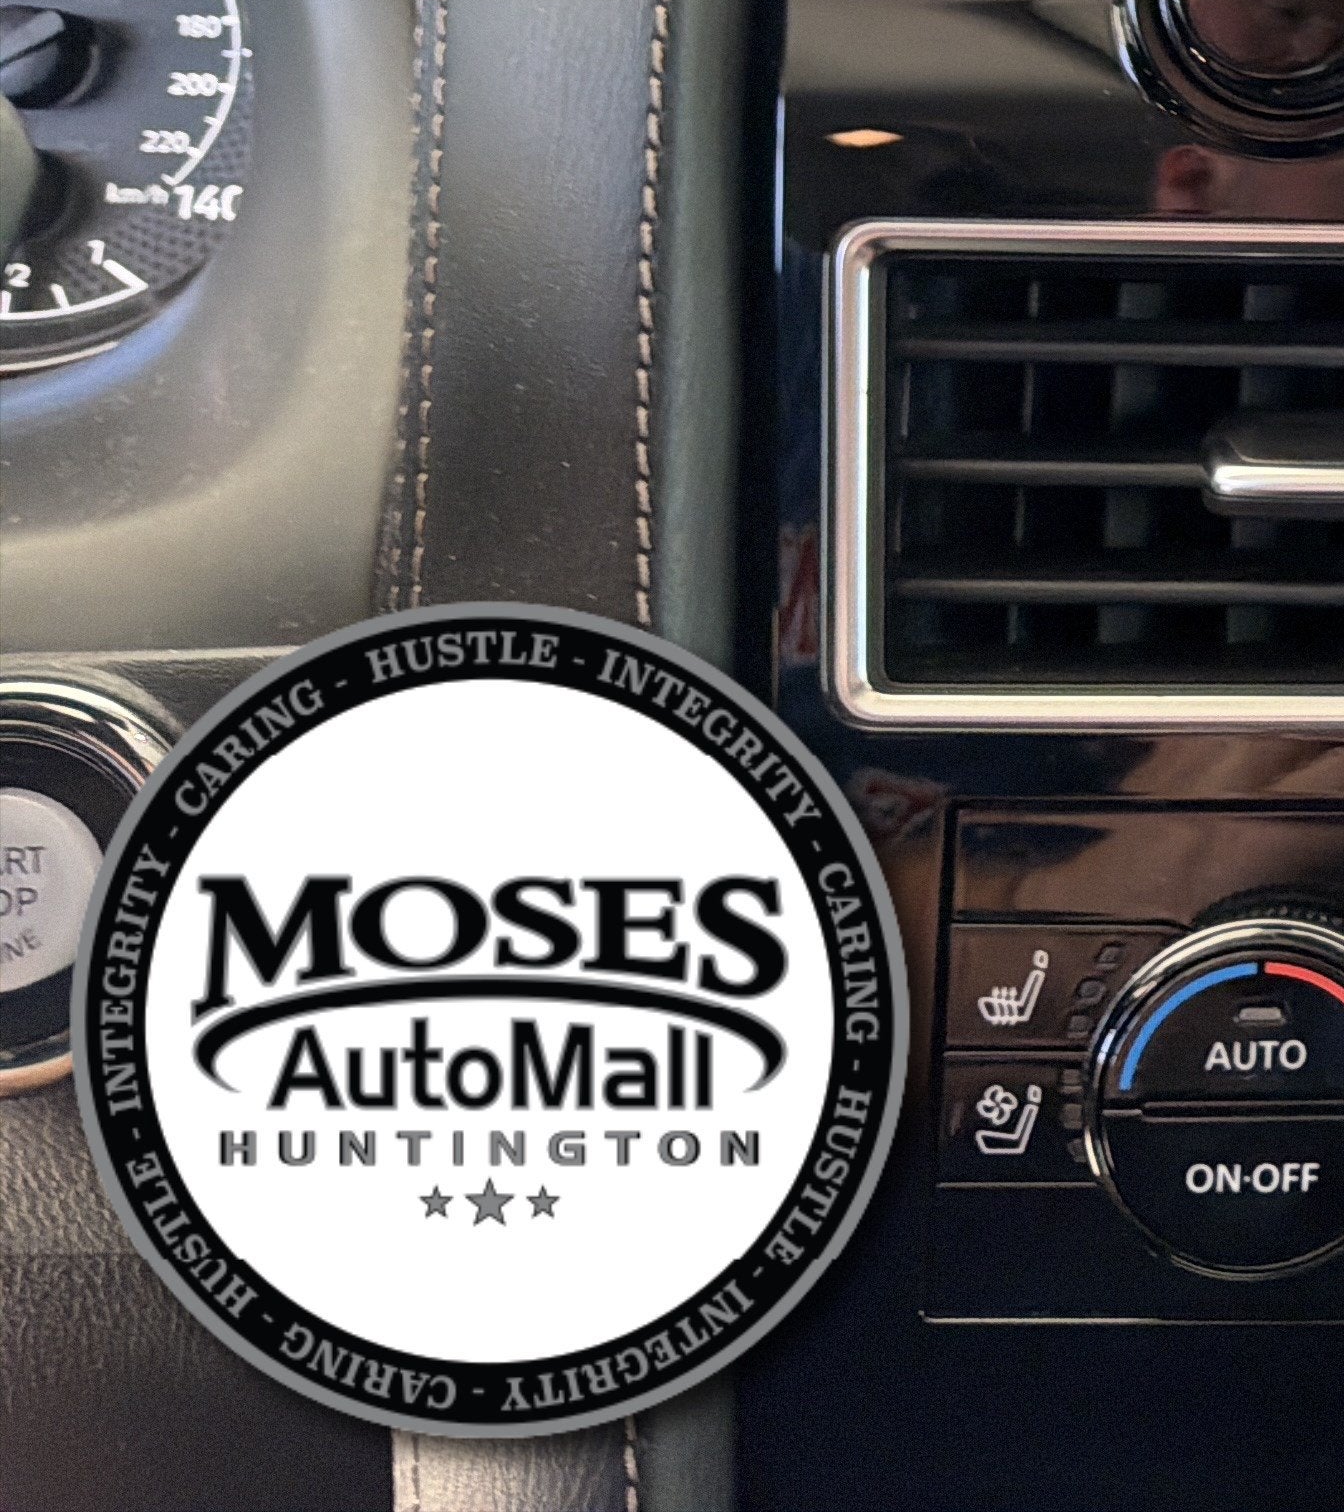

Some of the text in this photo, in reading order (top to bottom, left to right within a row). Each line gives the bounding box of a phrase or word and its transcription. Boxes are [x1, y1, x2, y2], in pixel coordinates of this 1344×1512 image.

[176, 13, 223, 39] 180
[167, 71, 219, 97] 200
[139, 129, 190, 154] 220
[4, 263, 32, 288] 2
[1204, 1039, 1308, 1073] AUTO
